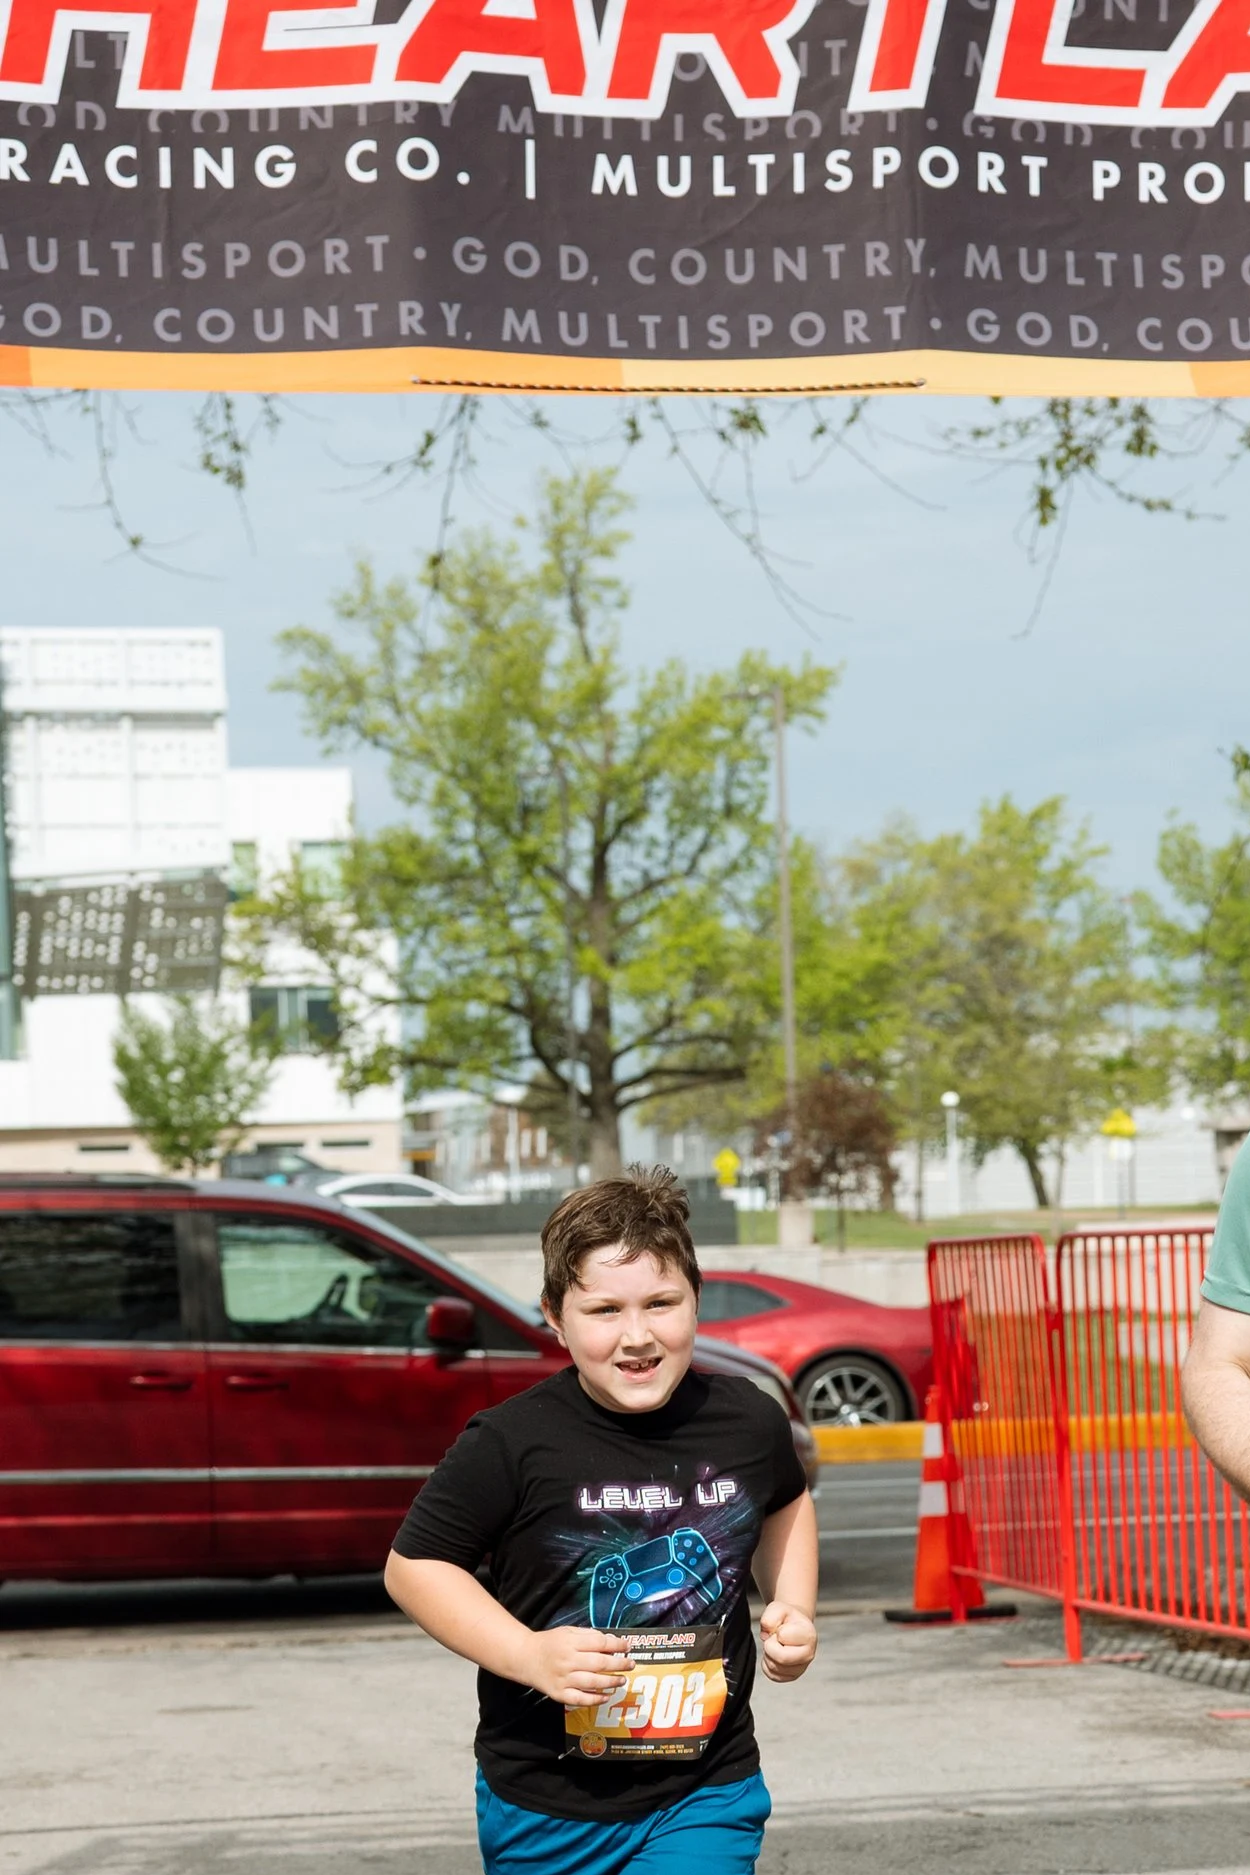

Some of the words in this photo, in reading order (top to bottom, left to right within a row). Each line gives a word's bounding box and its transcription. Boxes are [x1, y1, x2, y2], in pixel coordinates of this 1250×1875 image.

[0, 137, 297, 190] RACING
[345, 136, 470, 186] CO.
[591, 145, 1048, 198] MULTISPORT
[0, 234, 390, 279] ULTISPORT
[452, 236, 599, 285] GOD,
[628, 238, 936, 287] COUNTRY,
[0, 302, 121, 345] OD,
[153, 301, 473, 345] COUNTRY,
[501, 306, 907, 350] MULTISPORT
[967, 309, 1108, 353] GOD,
[579, 1486, 683, 1511] LEVEL
[696, 1479, 738, 1505] UP
[620, 1633, 696, 1646] HEARTLAND
[595, 1671, 706, 1729] 2302
